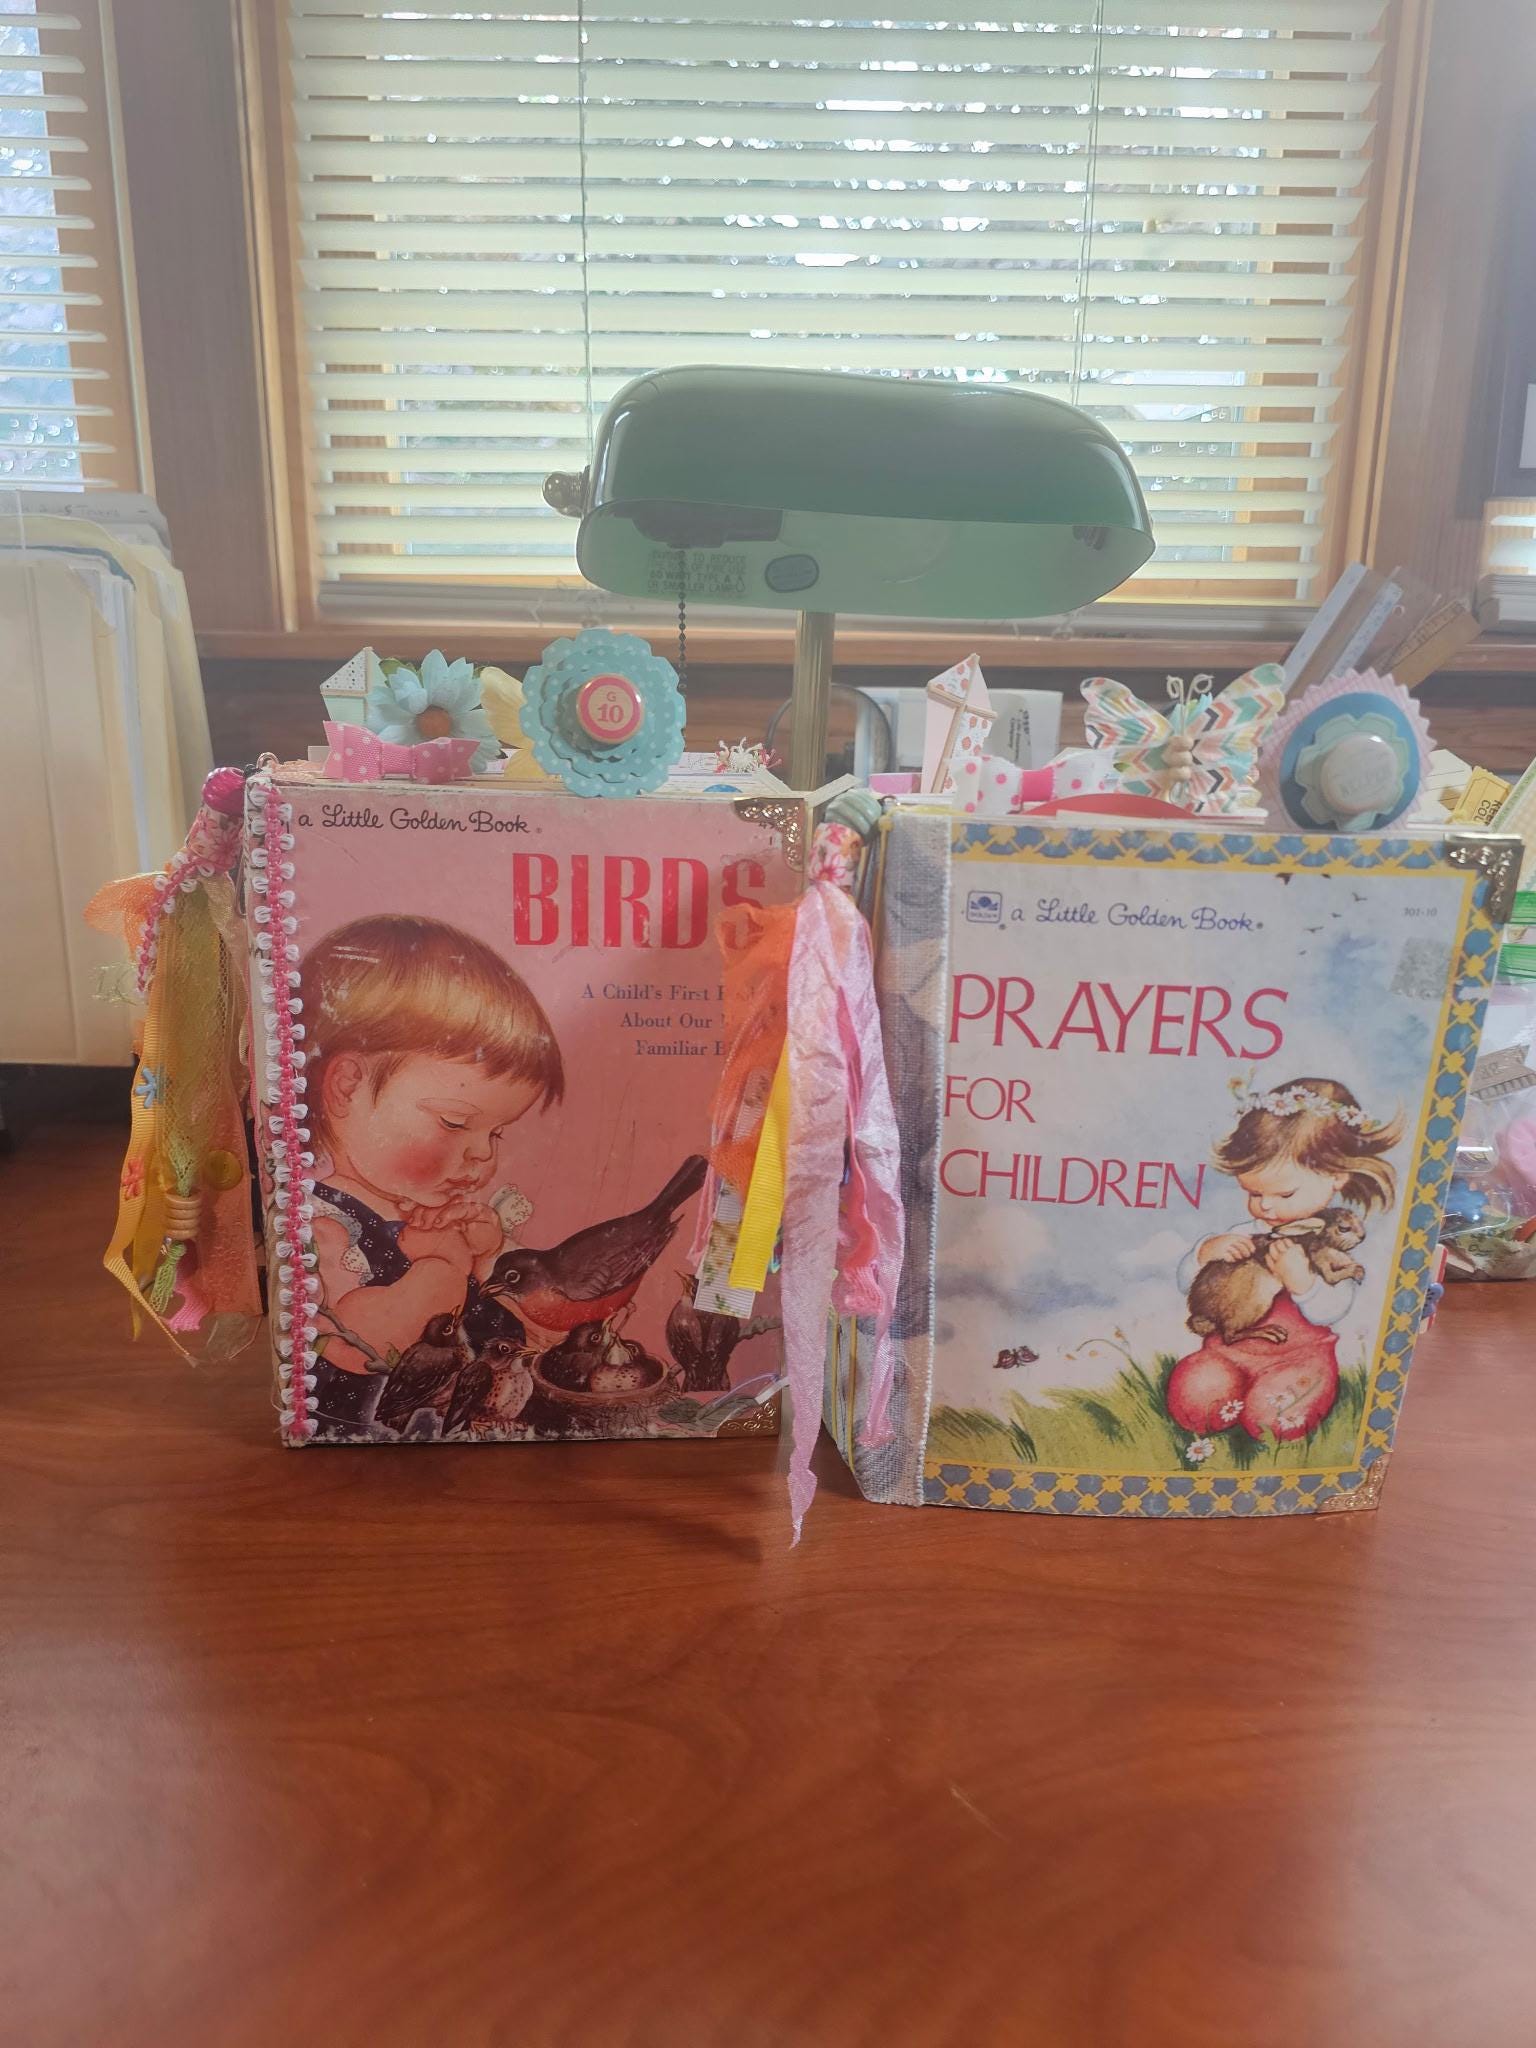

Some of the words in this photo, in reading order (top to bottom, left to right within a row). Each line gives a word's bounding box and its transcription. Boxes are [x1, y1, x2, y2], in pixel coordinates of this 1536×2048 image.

[607, 691, 617, 702] G
[597, 703, 624, 723] 10
[298, 813, 313, 827] a
[322, 803, 384, 829] Little
[390, 807, 467, 832] Golden
[469, 810, 530, 834] Book
[512, 851, 766, 950] BIRDS
[1010, 907, 1025, 921] a
[1036, 898, 1098, 924] Little
[1107, 903, 1187, 929] Golden
[1191, 907, 1254, 932] Book
[582, 984, 595, 999] A
[602, 983, 663, 1000] Child's
[671, 985, 710, 1000] First
[621, 1012, 672, 1028] About
[680, 1012, 713, 1029] Our
[949, 973, 1290, 1060] PRAYERS
[635, 1040, 708, 1056] Familiar
[942, 1075, 1036, 1123] FOR
[940, 1149, 1207, 1211] CHILDREN
